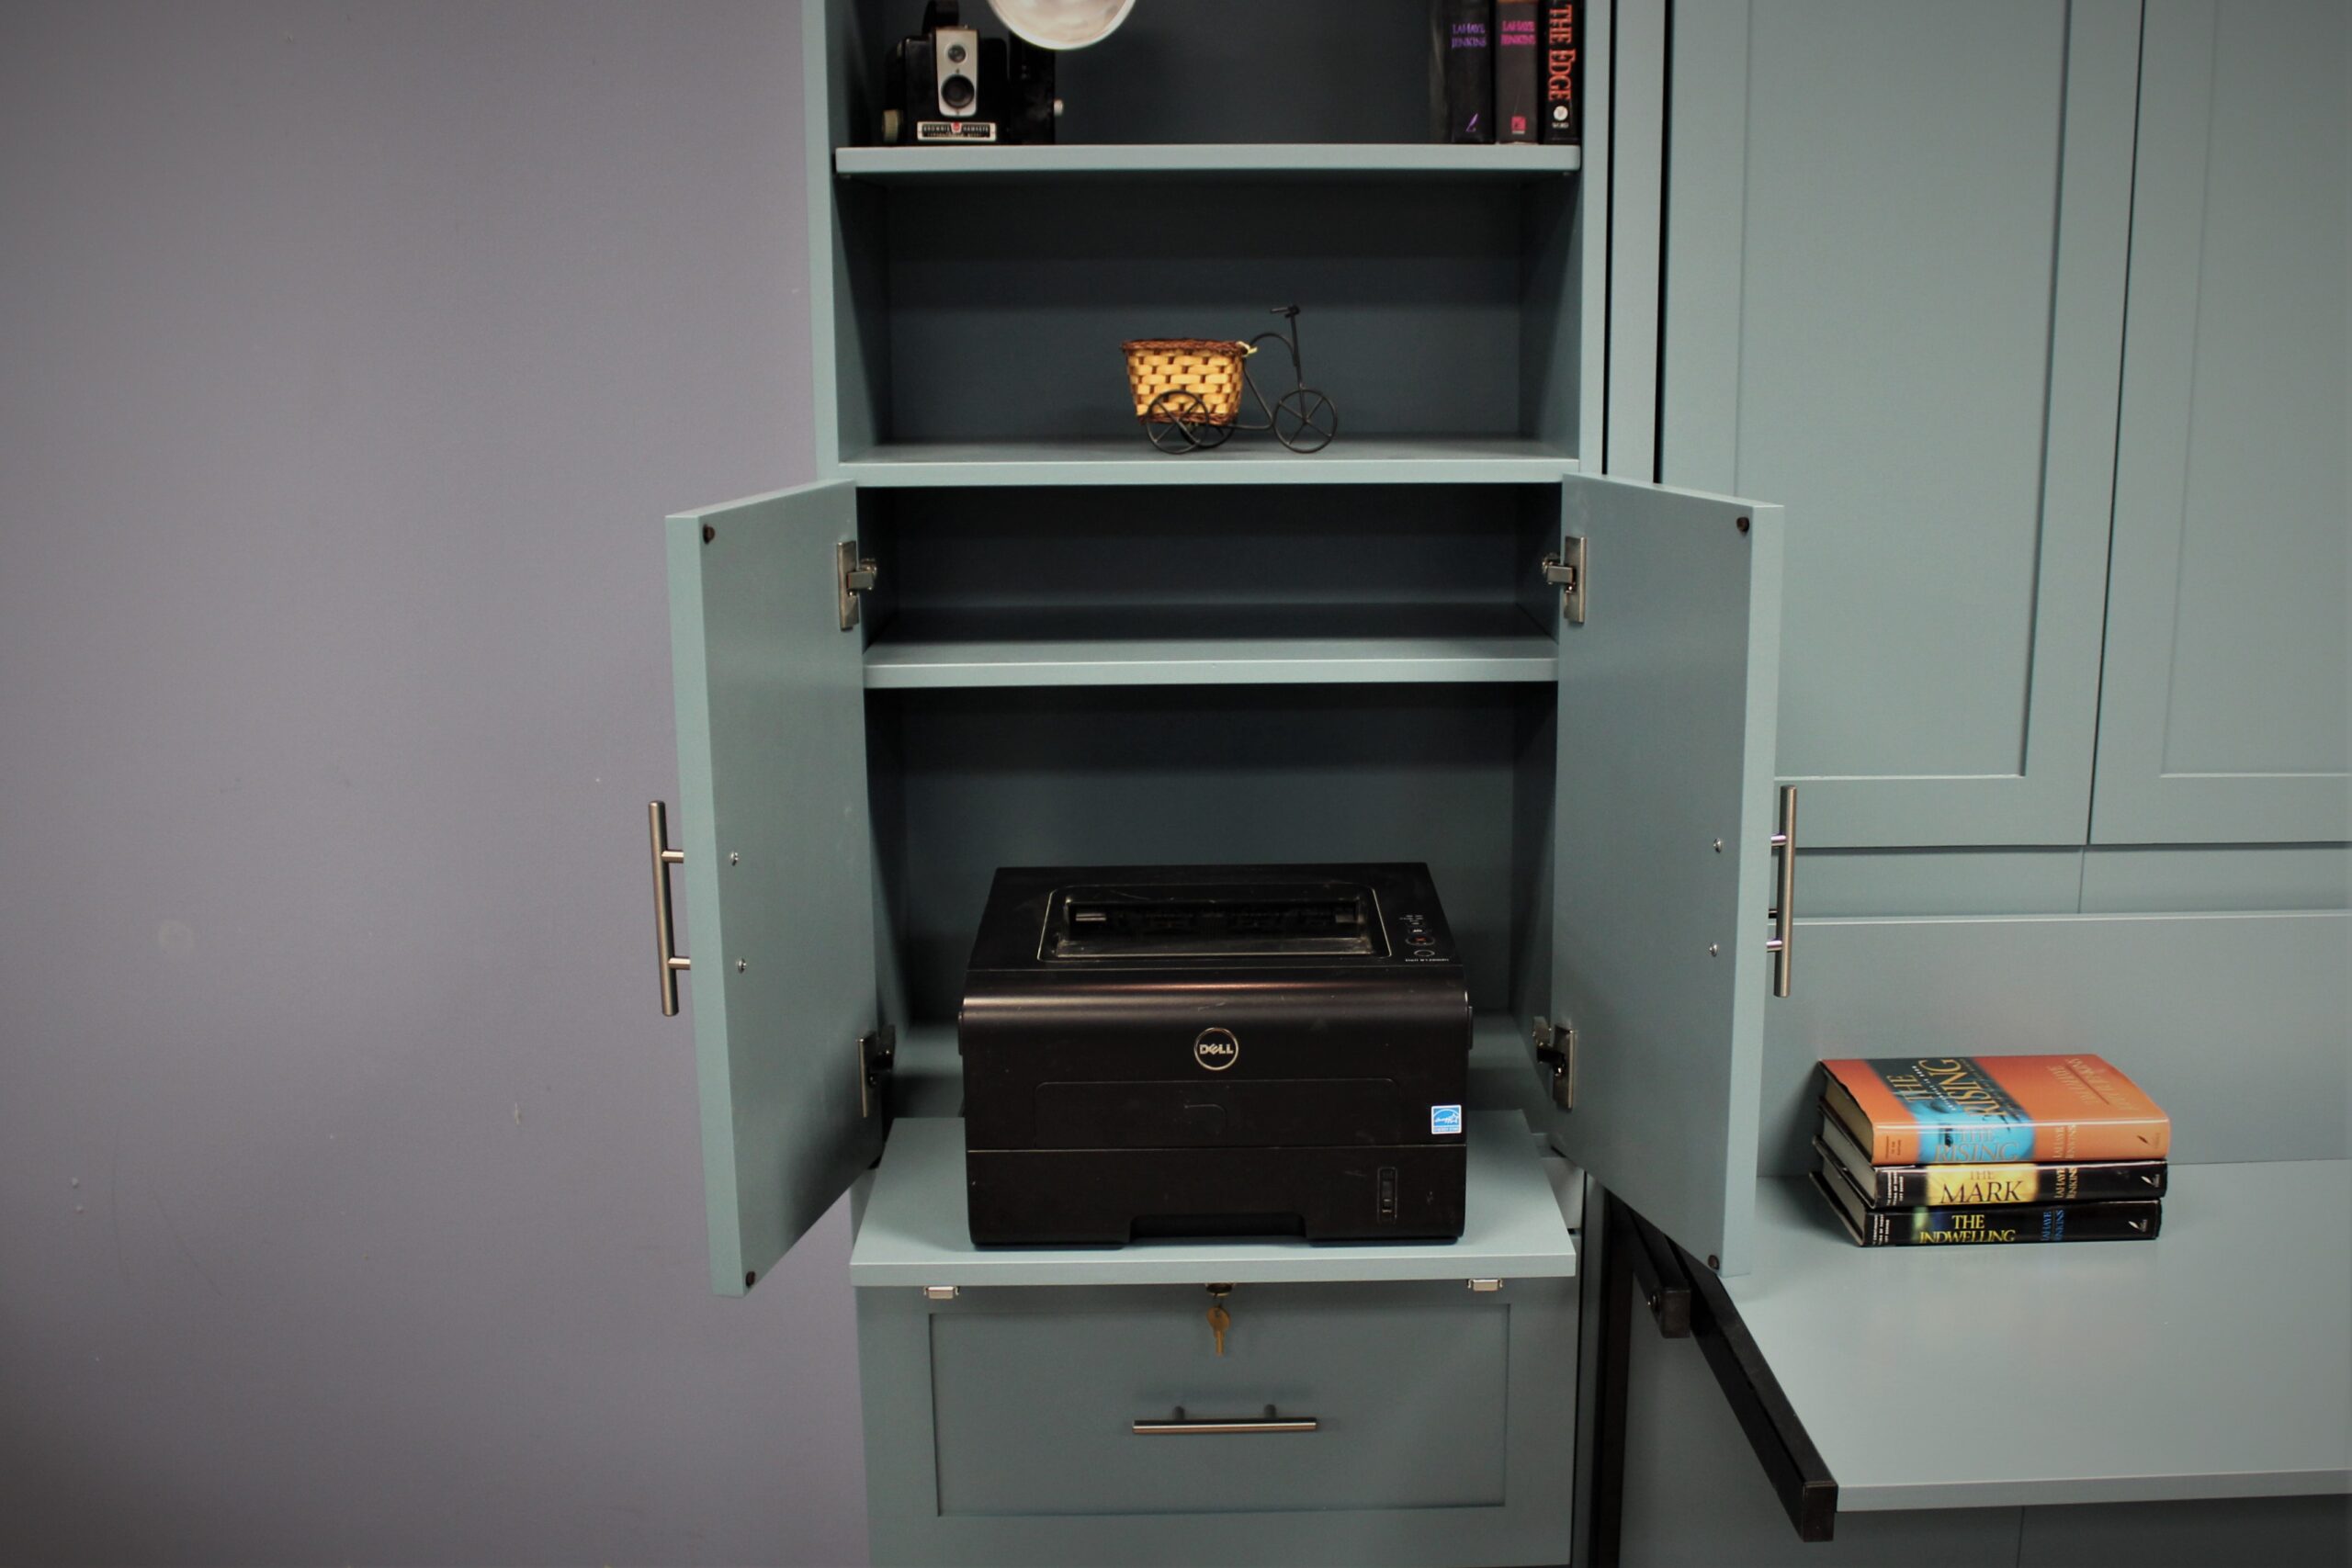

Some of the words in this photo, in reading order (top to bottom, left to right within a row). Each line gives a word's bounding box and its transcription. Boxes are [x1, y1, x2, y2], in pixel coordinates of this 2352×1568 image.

[1549, 5, 1573, 44] THE
[1548, 49, 1576, 101] EDGE
[1199, 1043, 1234, 1055] DELL
[1886, 1074, 1935, 1103] THE
[1918, 1058, 2008, 1118] RISING
[1960, 1127, 1995, 1143] THE
[1932, 1142, 2018, 1162] RISING
[1970, 1170, 1996, 1180] THE
[1940, 1181, 2024, 1204] MARK
[1951, 1214, 1985, 1229] THE
[1919, 1229, 2016, 1244] INDWELLING
